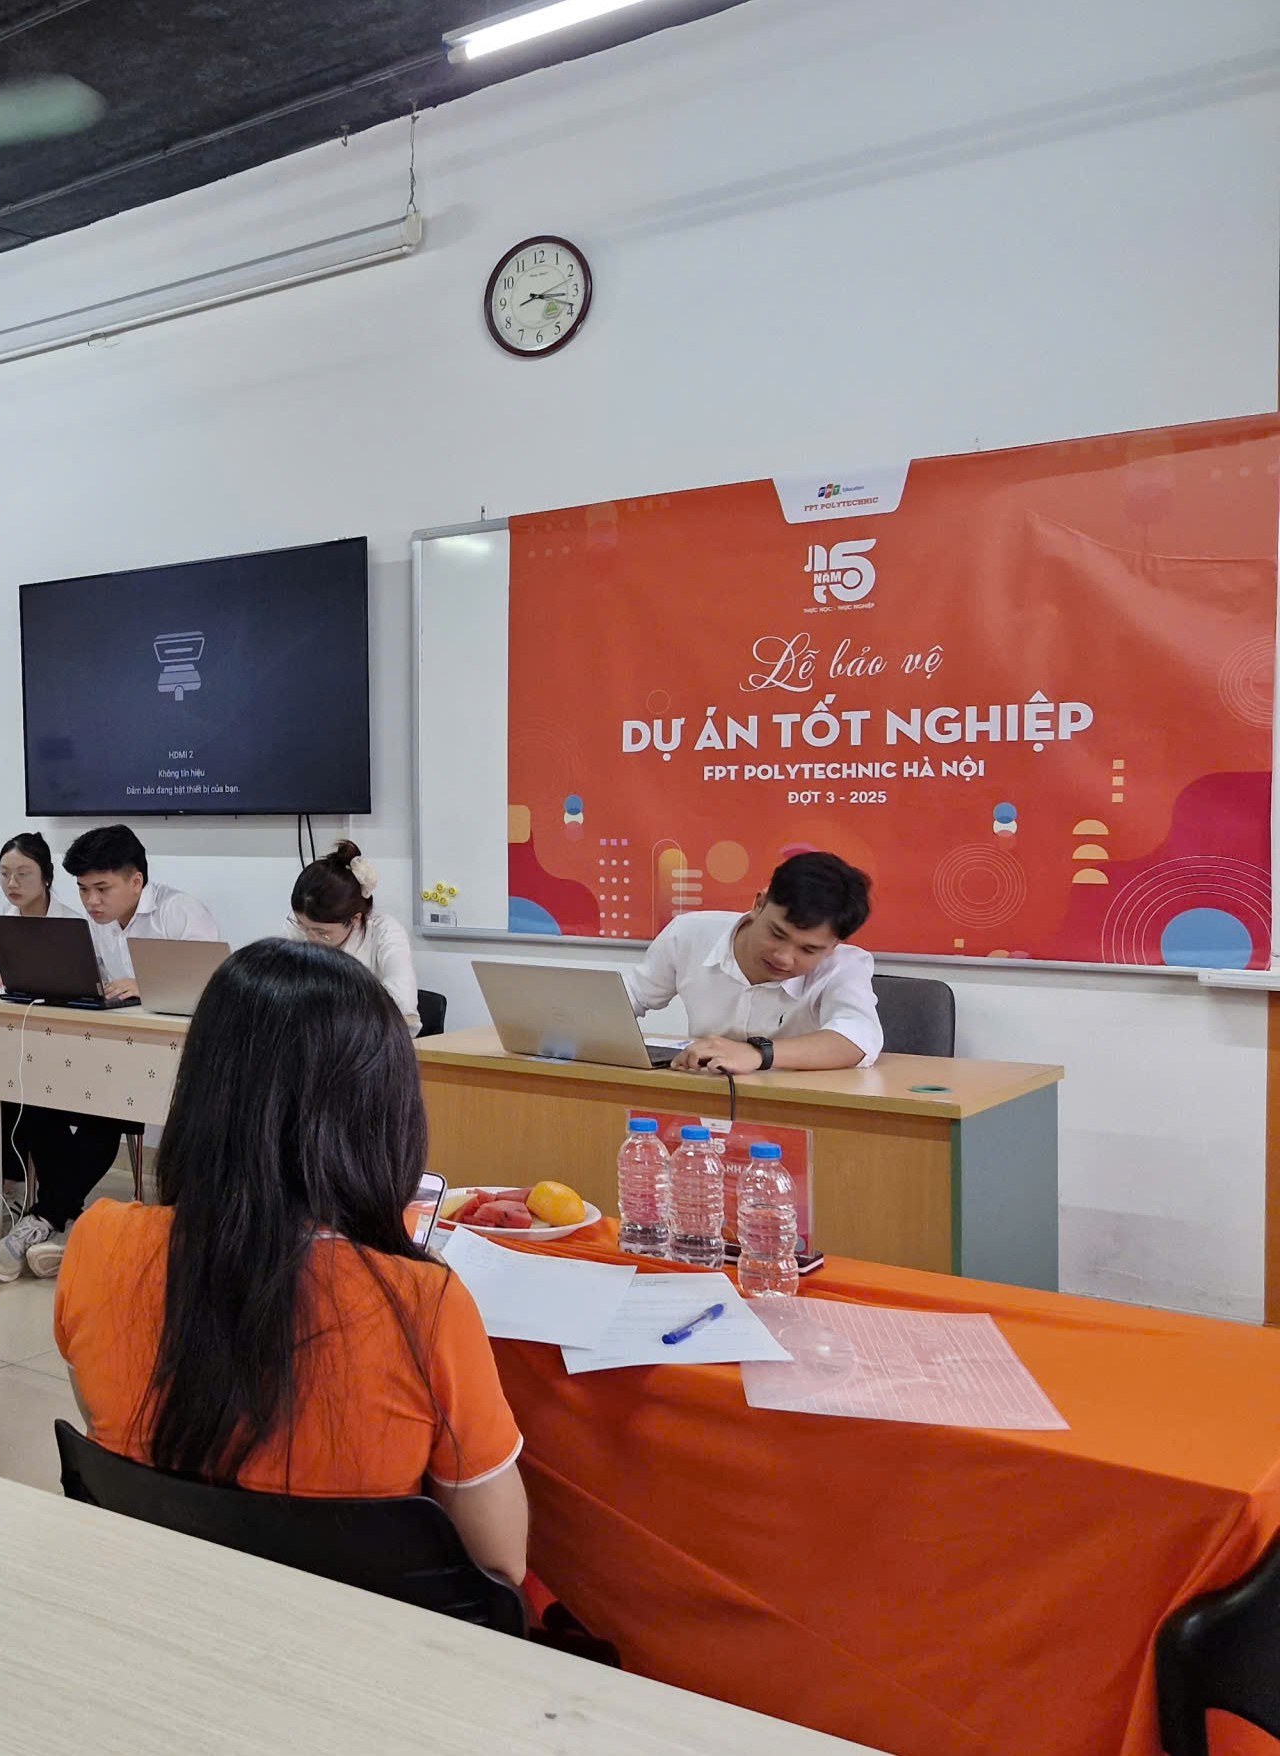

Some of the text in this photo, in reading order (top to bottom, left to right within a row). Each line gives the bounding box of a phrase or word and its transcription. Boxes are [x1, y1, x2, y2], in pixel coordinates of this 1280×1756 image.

[534, 250, 545, 264] 12
[555, 252, 559, 265] 1
[516, 259, 525, 273] 11
[567, 264, 574, 277] 2
[503, 276, 514, 290] 10
[572, 283, 579, 297] 3
[500, 298, 507, 311] 9
[567, 303, 574, 317] 4
[505, 316, 512, 329] 8
[554, 322, 561, 335] 5
[518, 329, 524, 341] 7
[536, 330, 543, 343] 6
[820, 497, 879, 510] POLYTECHNIC
[739, 632, 944, 692] Lễ bảo vệ
[622, 690, 1094, 761] DỰ ÁN TỐT NGHIỆP
[169, 750, 194, 759] HDMI 2
[158, 769, 179, 779] Không
[191, 768, 205, 778] hiệu
[703, 755, 985, 781] FPT POLYTECHNIC HÀ NỘI
[156, 786, 173, 796] đang
[211, 783, 223, 793] của
[788, 790, 821, 806] ĐỢT
[826, 792, 835, 804] 3
[849, 791, 887, 803] 2025
